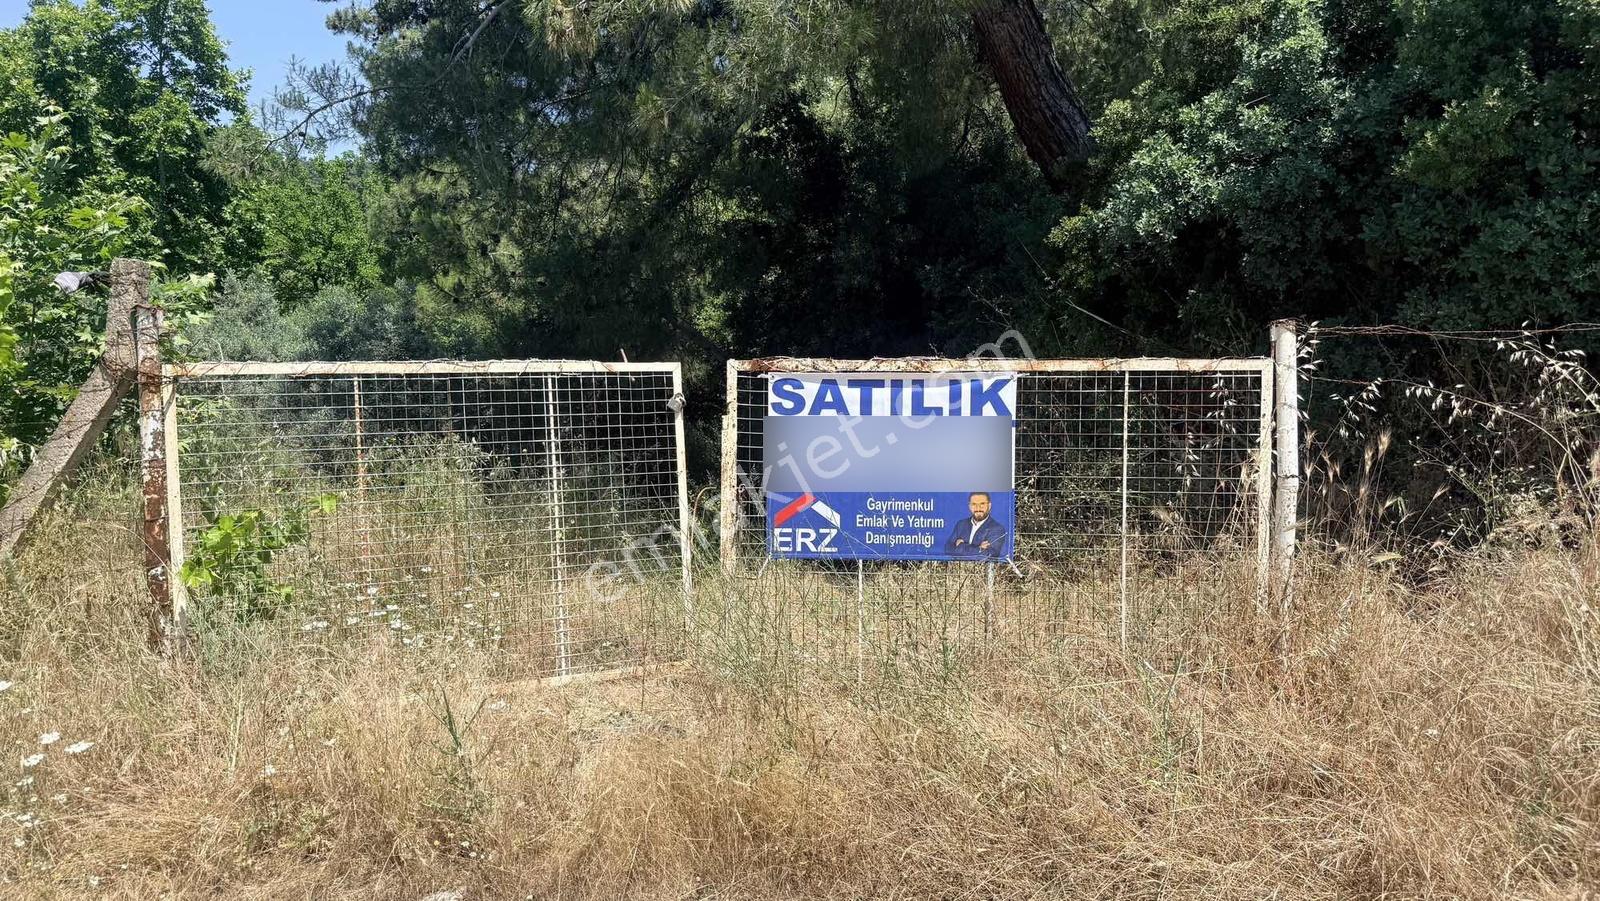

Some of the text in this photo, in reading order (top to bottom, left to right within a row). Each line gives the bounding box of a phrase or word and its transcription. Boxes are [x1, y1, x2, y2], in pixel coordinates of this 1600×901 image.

[770, 378, 1013, 416] SATILIK
[866, 498, 934, 514] Gayrimenkul
[856, 515, 944, 528] Emlak Ve Yatırım
[773, 527, 839, 553] ERZ
[866, 531, 935, 548] Danışmanlığı
